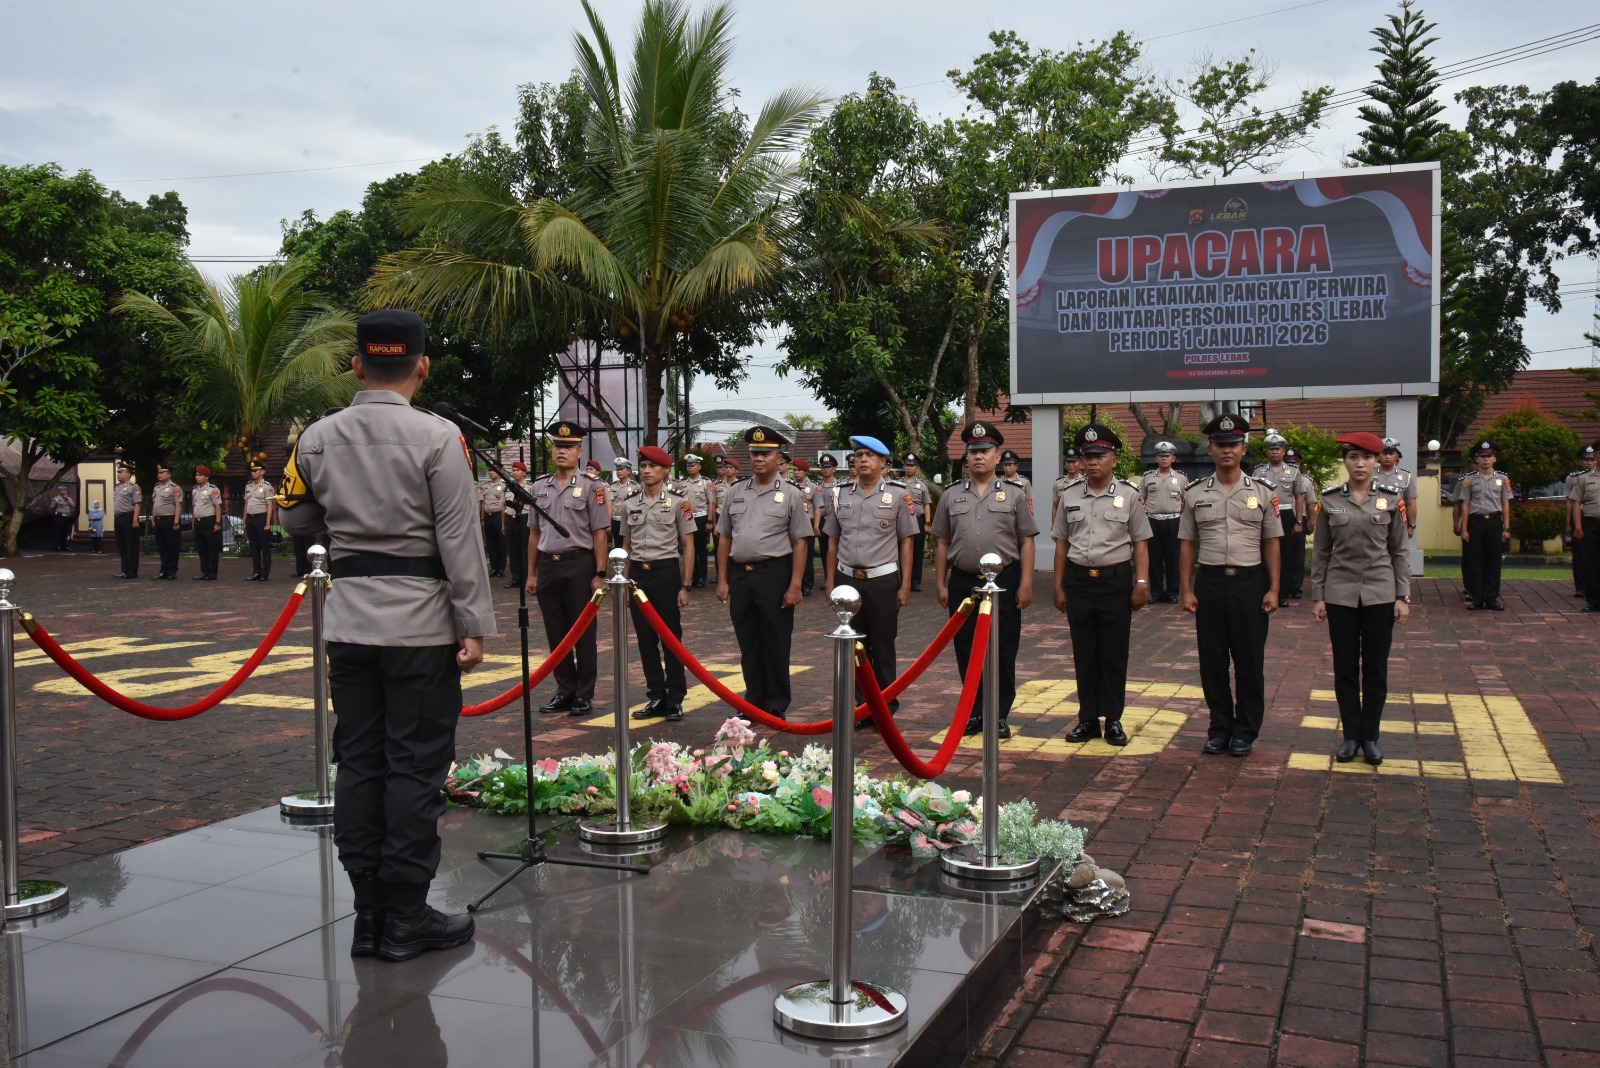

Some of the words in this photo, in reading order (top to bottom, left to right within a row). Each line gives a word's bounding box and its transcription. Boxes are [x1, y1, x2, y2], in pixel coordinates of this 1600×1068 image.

[1210, 211, 1247, 220] LEBAK
[1097, 224, 1333, 285] UPACARA
[1057, 288, 1130, 310] LAPORAN
[1134, 284, 1218, 307] KENAIKAN
[1222, 279, 1302, 303] PANGKAT
[1306, 274, 1387, 299] PERWIRA
[1059, 311, 1092, 332] DAN
[1096, 308, 1165, 331] BINTARA
[1170, 305, 1253, 328] PERSONIL
[1257, 302, 1324, 324] POLRES
[1328, 298, 1386, 322] LEBAK
[1109, 329, 1180, 351] PERIODE
[1183, 328, 1193, 349] 1
[1196, 325, 1273, 348] JANUARI
[1276, 323, 1329, 346] 2026
[1185, 354, 1218, 364] POLRES
[1220, 352, 1249, 363] LEBAK
